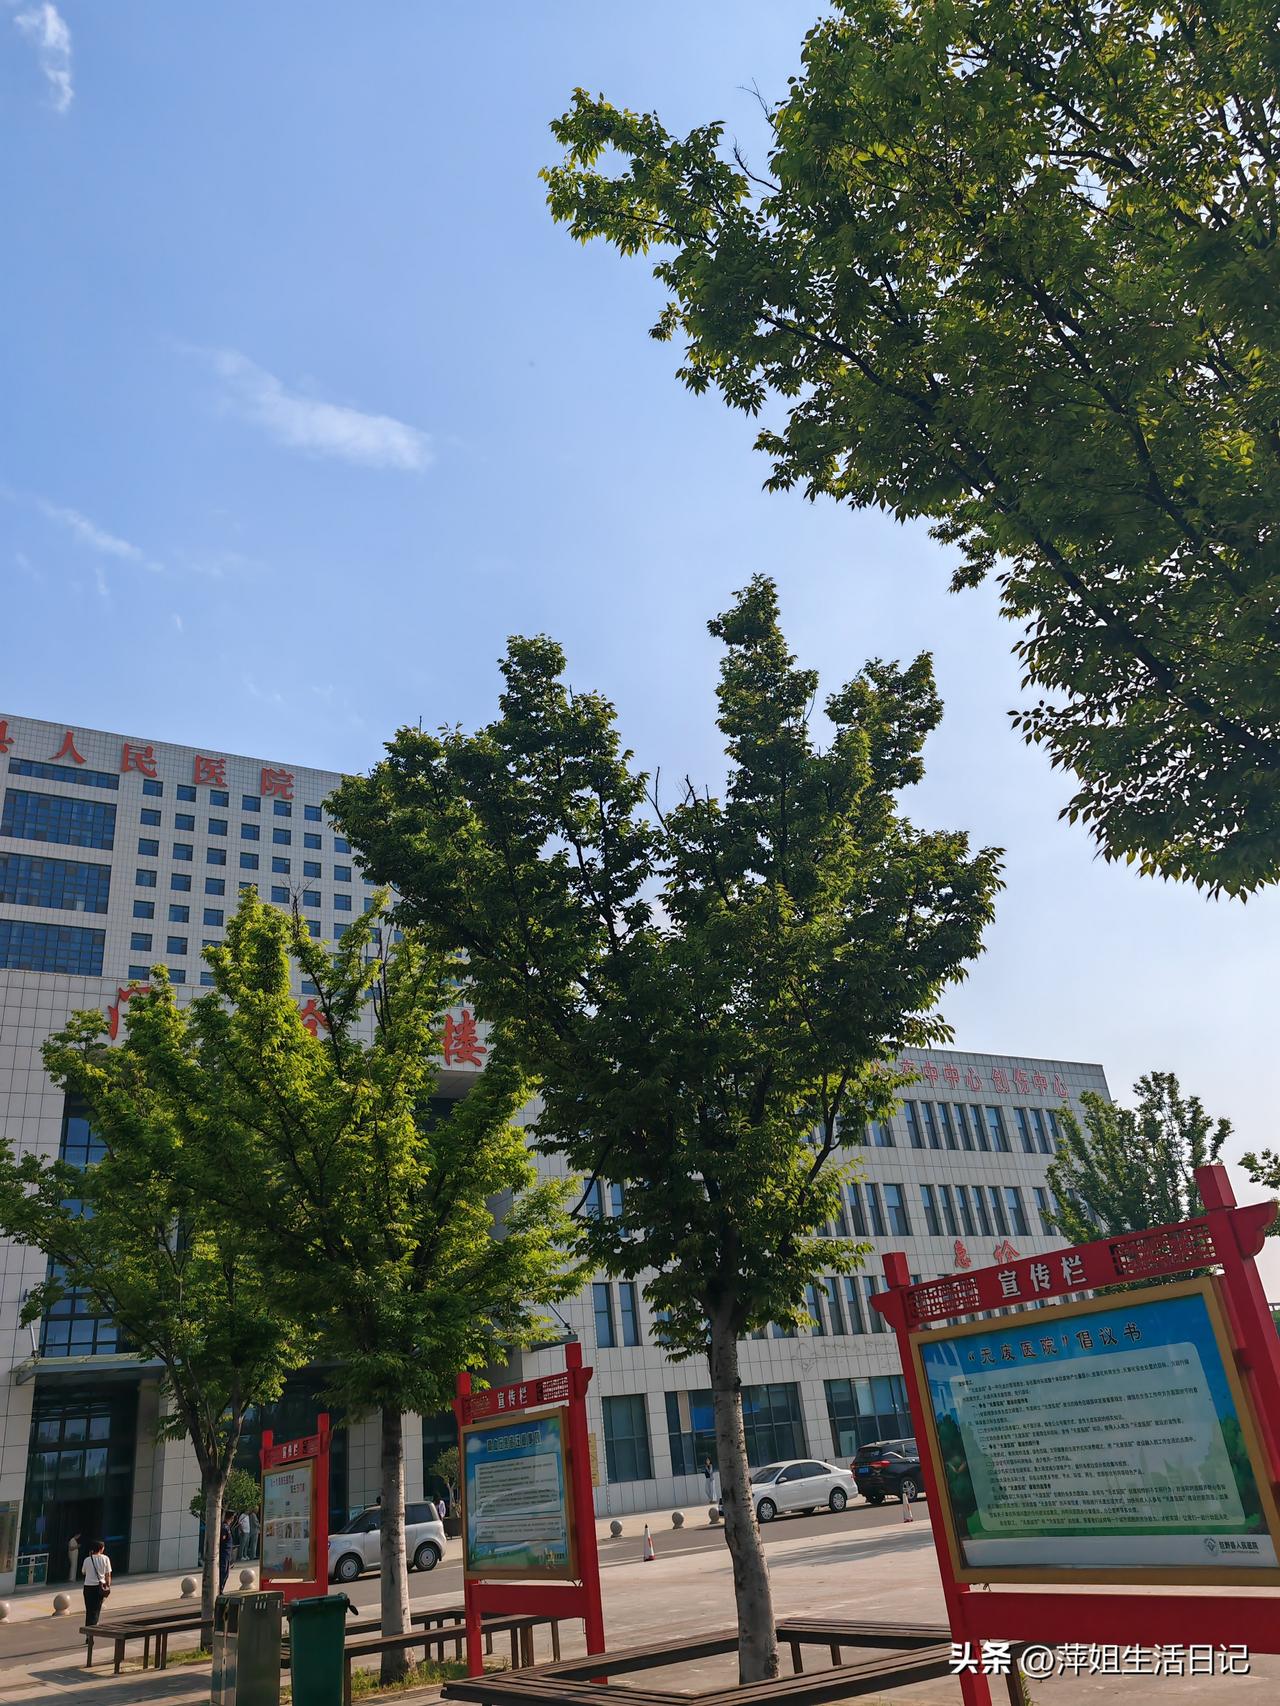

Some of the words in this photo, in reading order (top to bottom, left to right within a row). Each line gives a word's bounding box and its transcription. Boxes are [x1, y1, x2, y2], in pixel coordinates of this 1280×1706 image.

[991, 1067, 1070, 1098] 创伤中心
[997, 1254, 1087, 1298] 宣传栏
